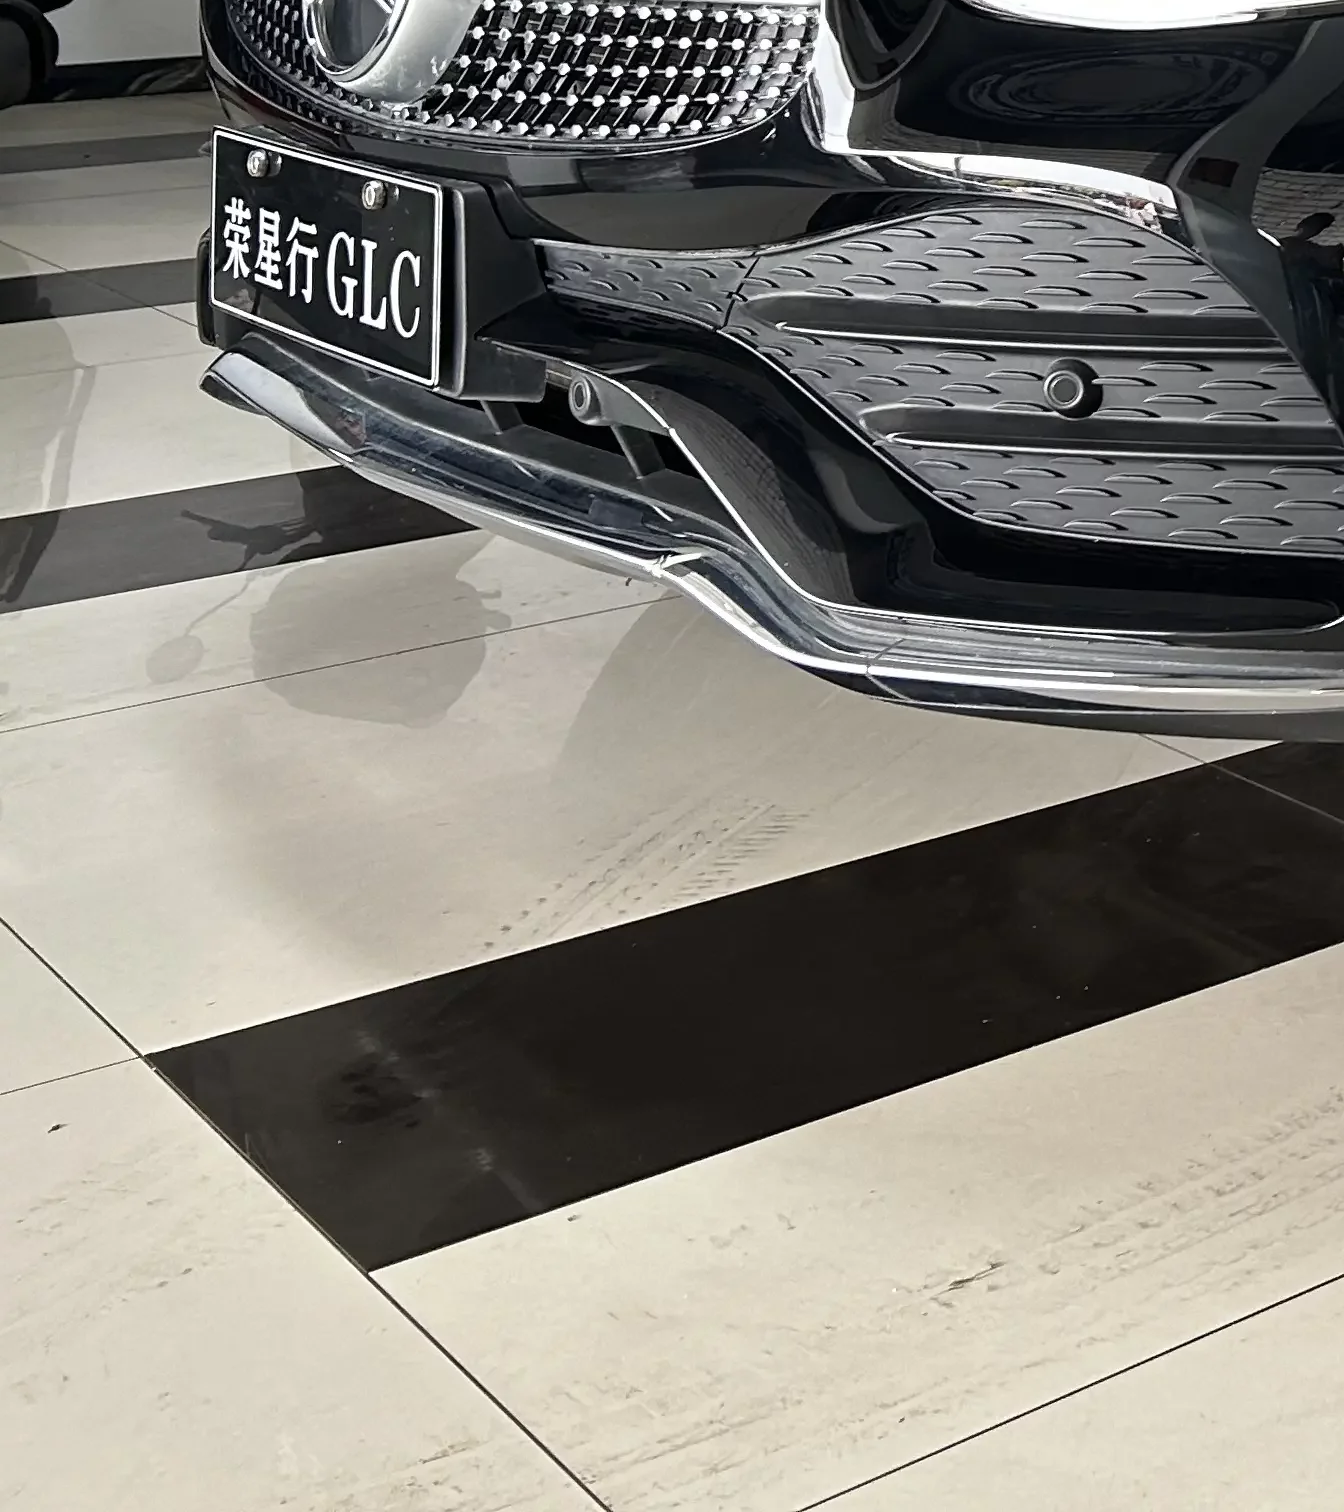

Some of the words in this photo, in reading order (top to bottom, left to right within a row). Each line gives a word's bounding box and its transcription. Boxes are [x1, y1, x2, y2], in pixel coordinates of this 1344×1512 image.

[221, 196, 319, 304] 荣星行
[326, 231, 421, 338] GLC
